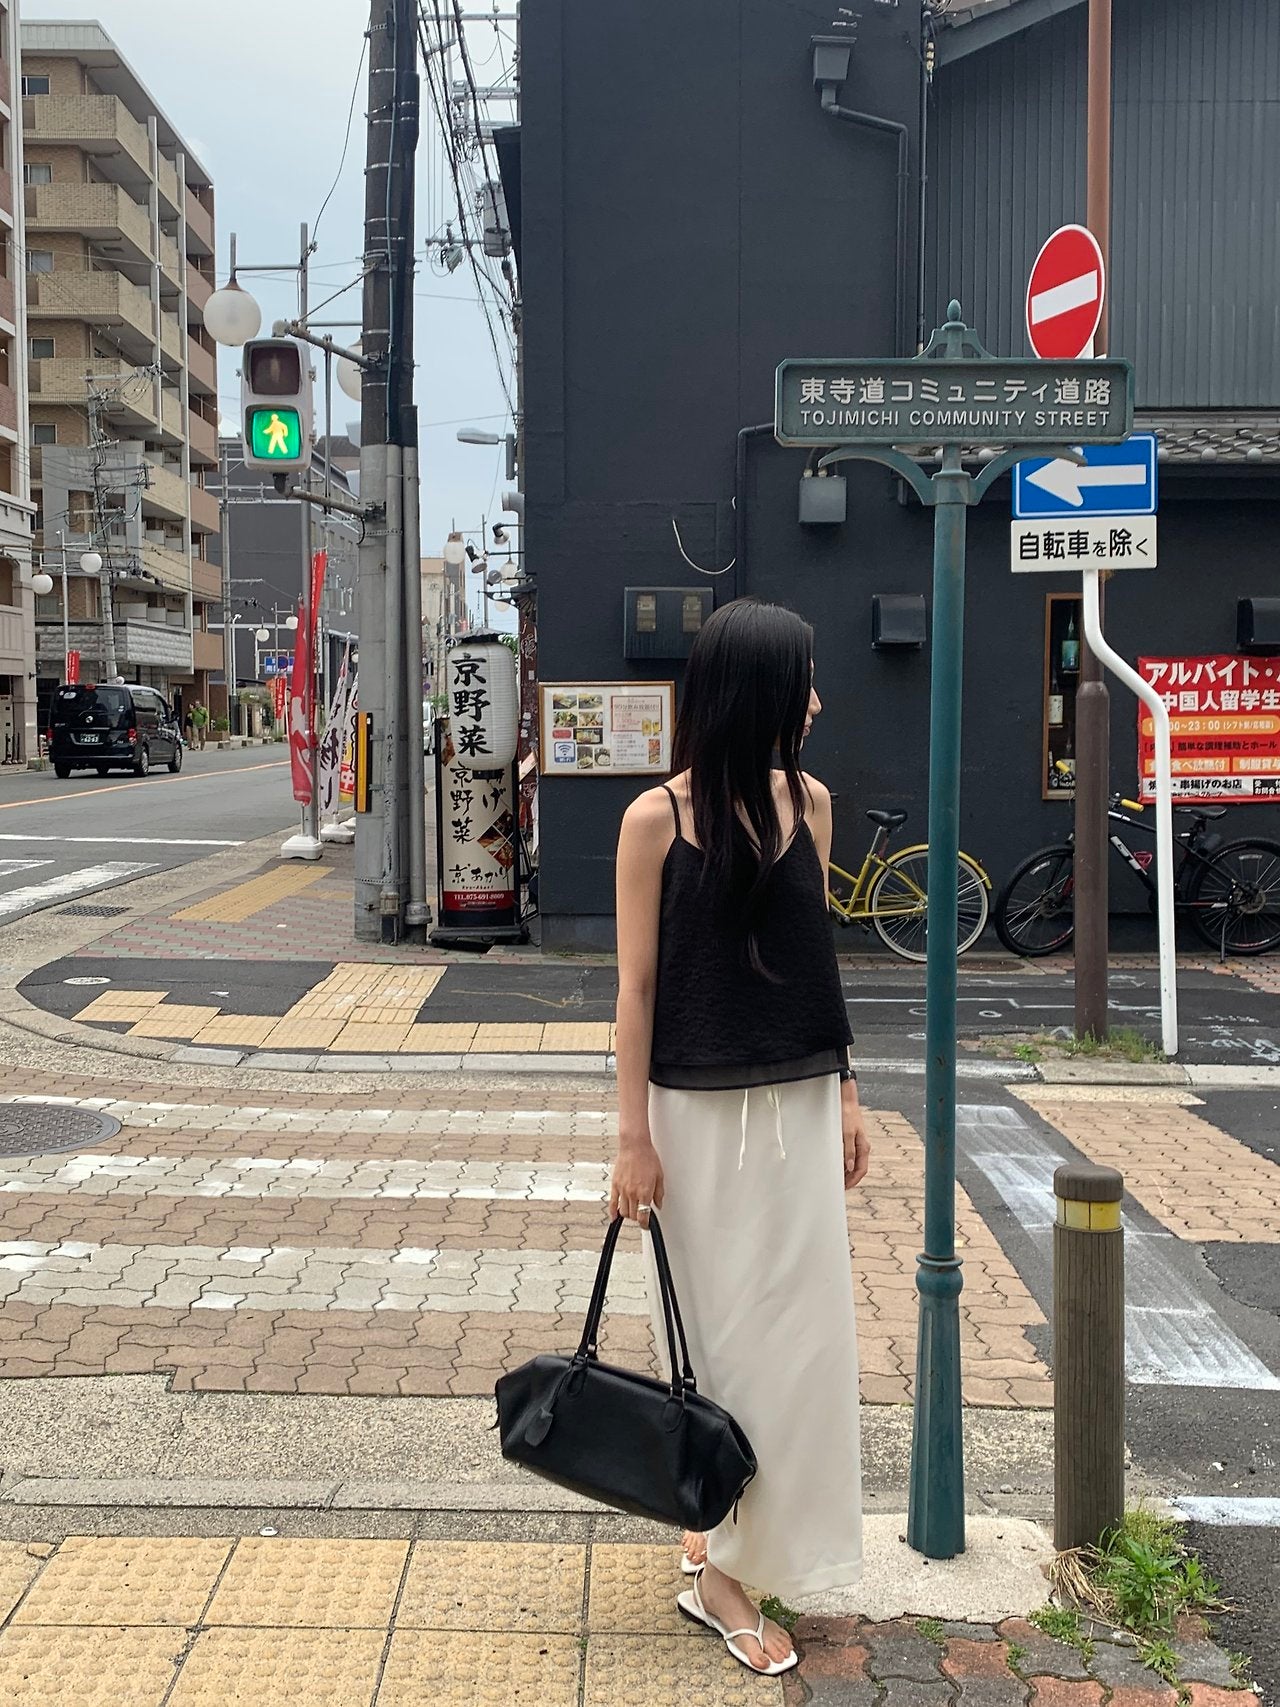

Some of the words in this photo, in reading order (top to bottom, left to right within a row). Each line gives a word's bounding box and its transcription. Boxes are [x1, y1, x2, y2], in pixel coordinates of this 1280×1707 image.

[800, 376, 1112, 405] 東寺道コミュニティ道路
[801, 410, 899, 426] TOJIMICHI
[909, 410, 1027, 426] COMMUNITY
[1034, 410, 1111, 426] STREET
[1020, 529, 1150, 560] 自転車を除く
[1145, 660, 1280, 687] アルバイト・
[451, 652, 494, 758] 京野菜
[450, 761, 476, 844] 京野菜
